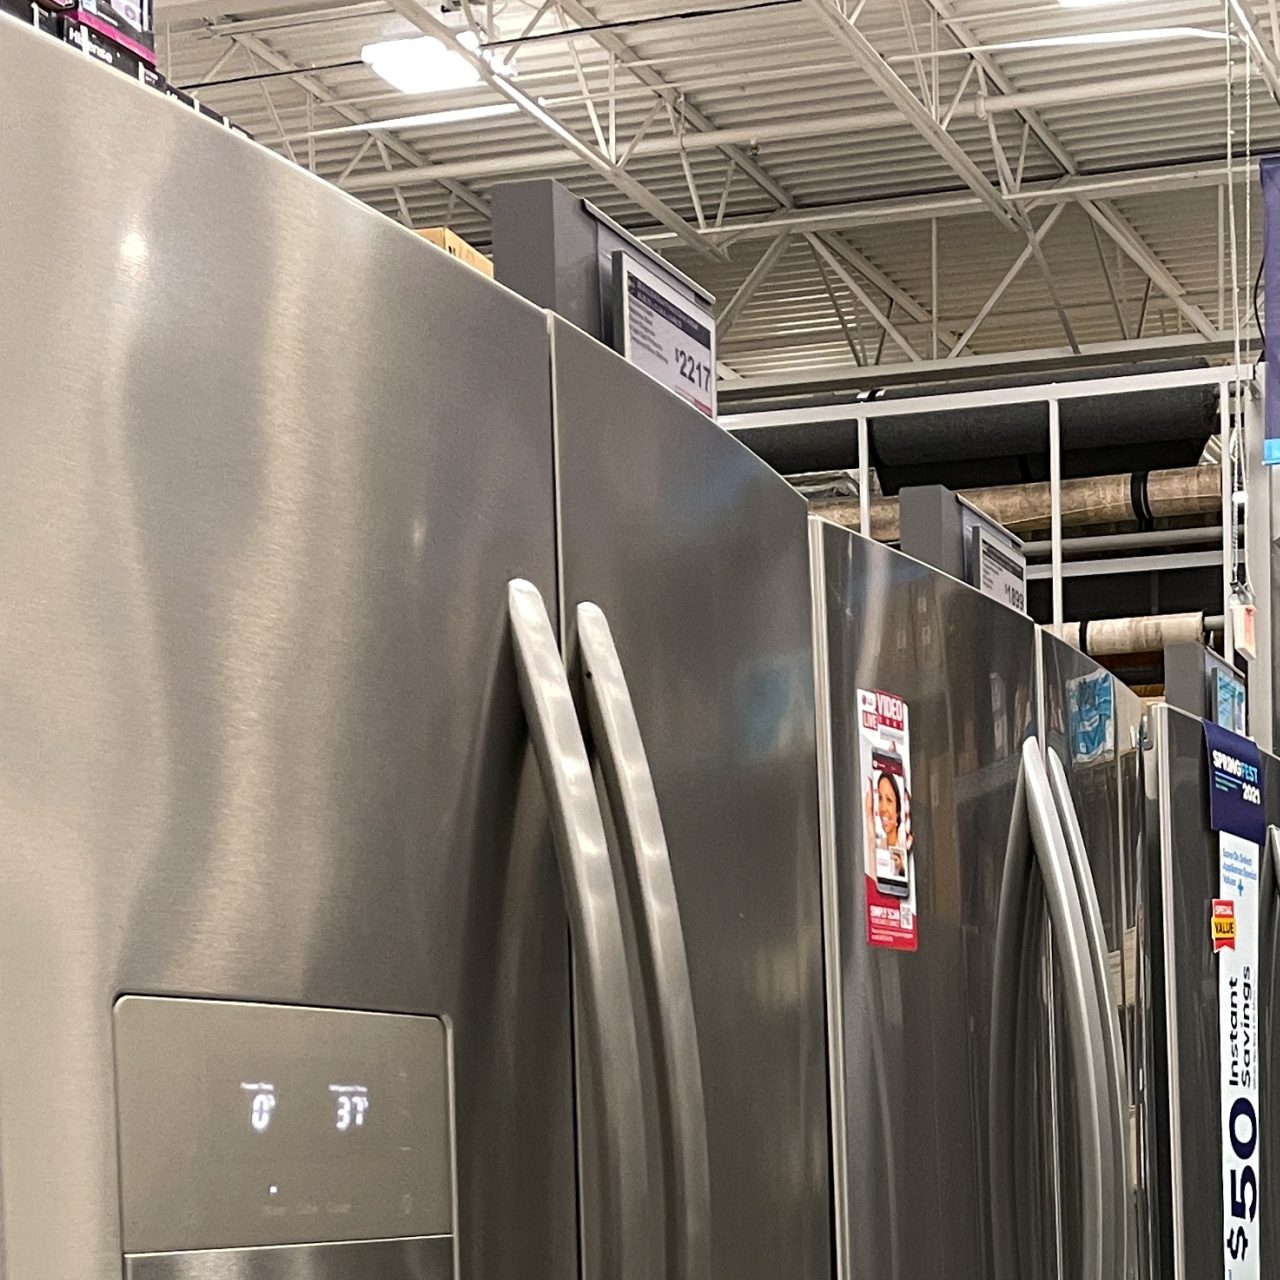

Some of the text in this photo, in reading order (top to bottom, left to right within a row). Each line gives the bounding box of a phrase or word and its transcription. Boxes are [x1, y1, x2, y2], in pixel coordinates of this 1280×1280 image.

[68, 26, 113, 64] Hiense
[876, 692, 903, 722] VIDEO
[1242, 782, 1261, 805] 2021
[1214, 921, 1234, 935] VALUE
[1229, 976, 1239, 1086] Instant
[1240, 965, 1252, 1089] Savings
[1227, 1097, 1257, 1261] $50
